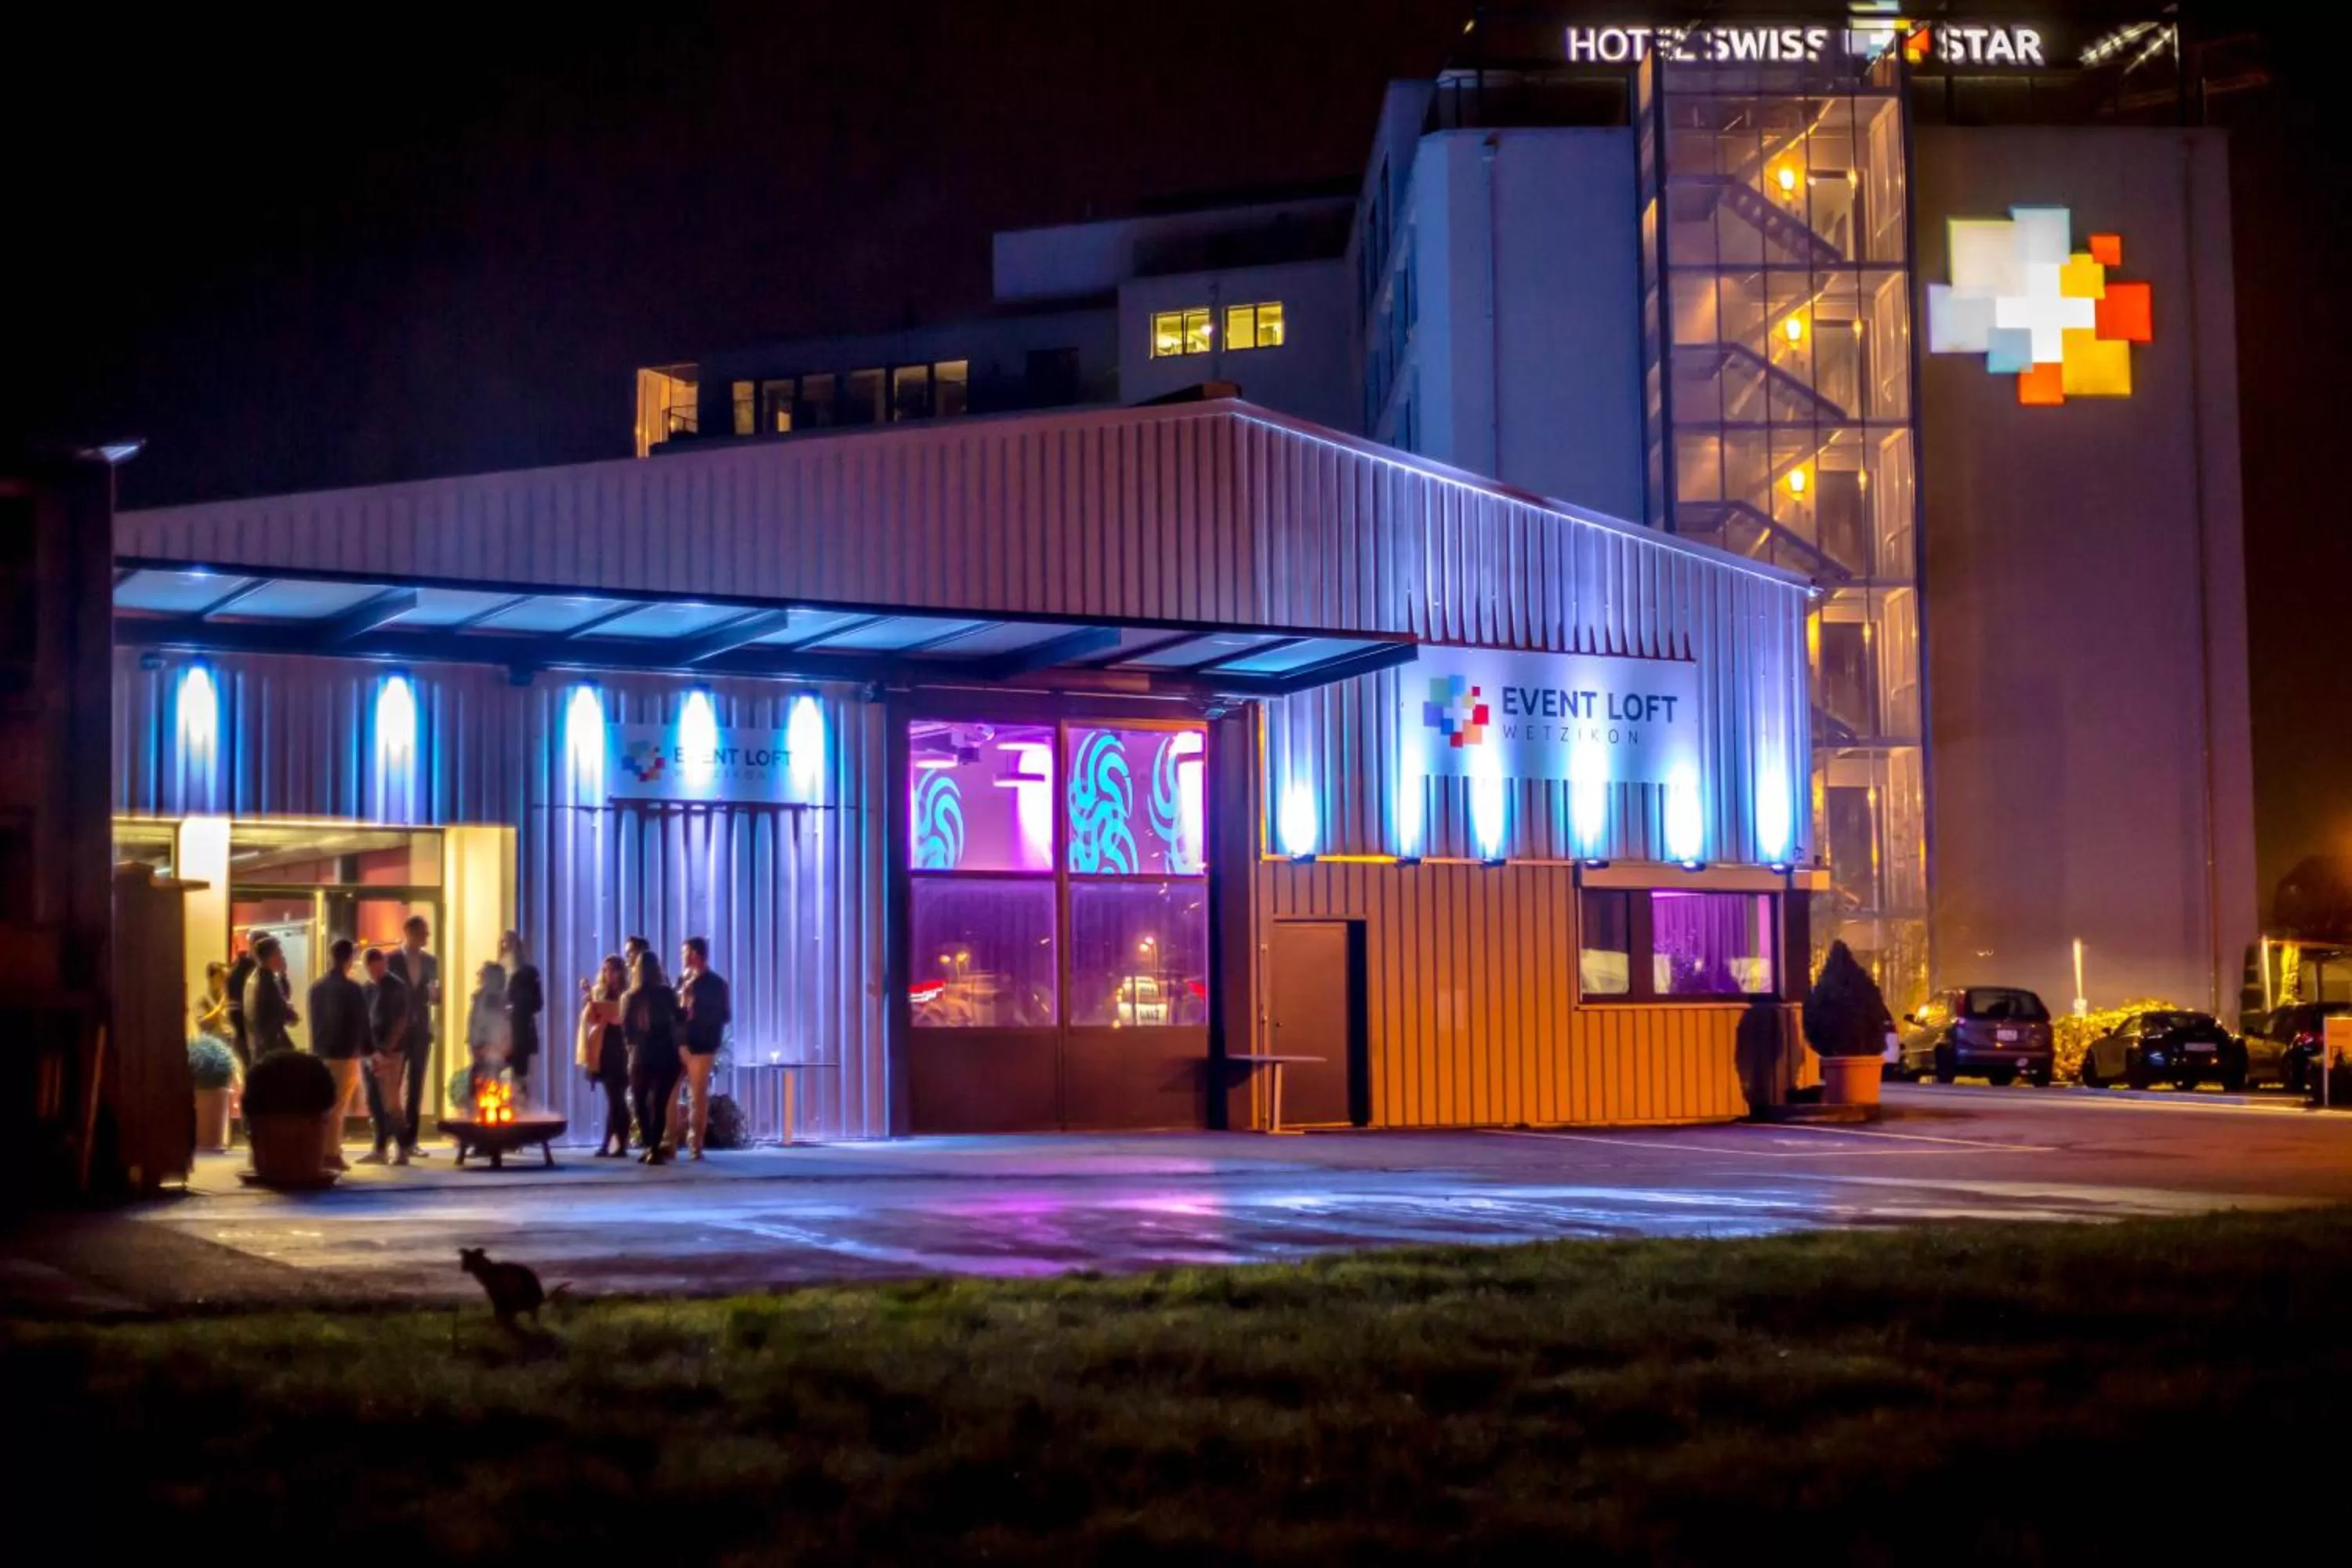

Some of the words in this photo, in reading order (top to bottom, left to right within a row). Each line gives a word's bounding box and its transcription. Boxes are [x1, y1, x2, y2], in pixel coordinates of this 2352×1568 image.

[1704, 27, 1828, 62] SWISS
[1937, 27, 2043, 64] STAR
[1501, 686, 1597, 719] EVENT
[1607, 692, 1678, 724] LOFT
[1502, 724, 1639, 744] WETZIKON
[673, 746, 739, 765] ENT
[746, 749, 792, 767] LOFT
